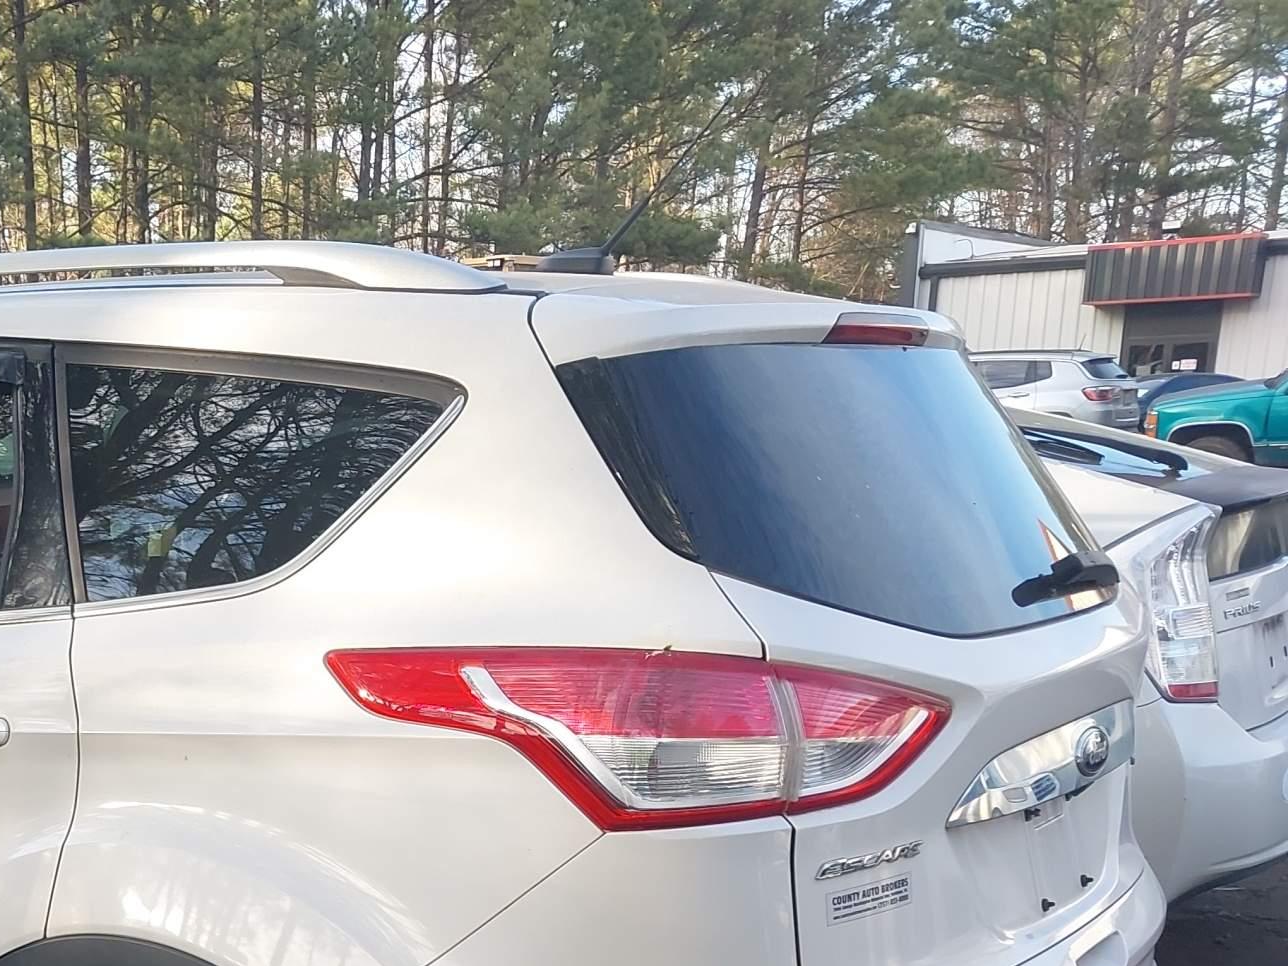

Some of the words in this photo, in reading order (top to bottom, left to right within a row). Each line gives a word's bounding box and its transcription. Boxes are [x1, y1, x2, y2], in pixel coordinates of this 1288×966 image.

[815, 839, 924, 880] ESCAPE
[831, 892, 861, 906] COUNTY
[861, 886, 880, 899] AUTO
[881, 878, 909, 893] BROKERS
